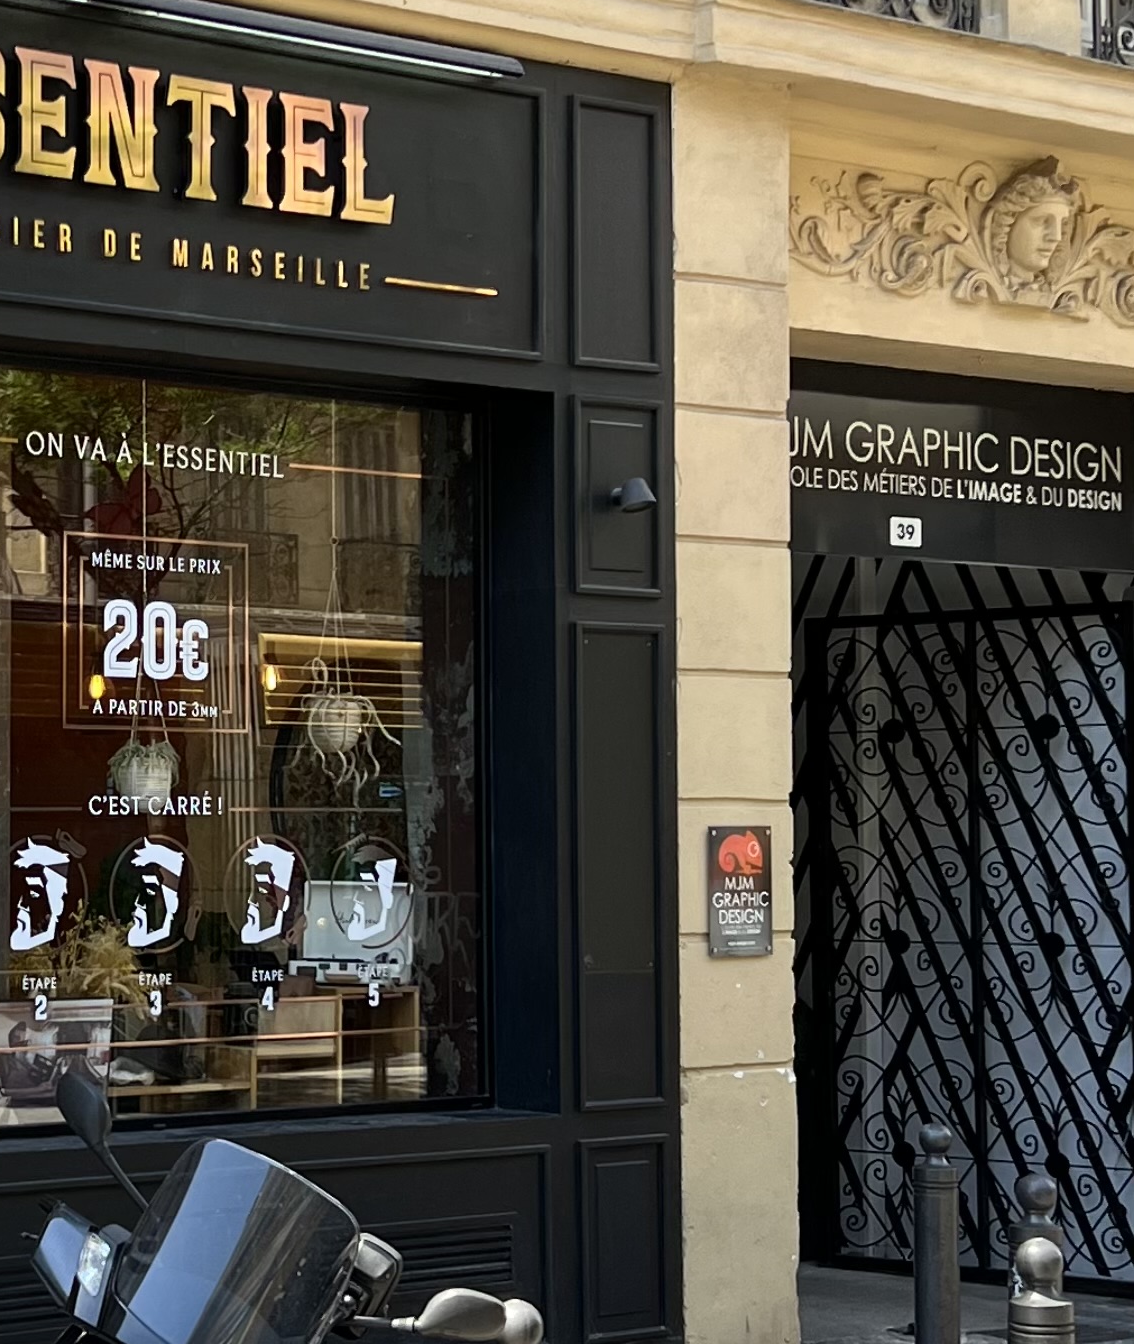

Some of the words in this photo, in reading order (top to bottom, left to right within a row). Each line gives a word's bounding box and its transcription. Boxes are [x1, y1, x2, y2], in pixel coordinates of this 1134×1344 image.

[104, 228, 141, 261] DE
[173, 238, 370, 290] MARSEILLE
[26, 430, 63, 457] ON
[74, 434, 107, 462] VA
[116, 433, 133, 464] À
[143, 442, 285, 479] L'ESSENTIEL
[789, 416, 834, 459] JM
[846, 421, 999, 473] GRAPHIC
[1010, 436, 1122, 483] DESIGN
[828, 469, 858, 491] DES
[864, 468, 926, 498] MÉTIERS
[931, 477, 953, 498] DE
[957, 480, 1022, 504] L'IMAGE
[1026, 486, 1037, 505] &
[1042, 487, 1063, 506] DU
[1067, 489, 1123, 511] DESIGN
[896, 523, 915, 541] 39
[92, 549, 132, 569] MÊME
[137, 555, 165, 572] SUR
[169, 557, 185, 573] LE
[189, 558, 221, 575] PRIX
[103, 599, 209, 681] 20€
[109, 699, 164, 716] PARTIR
[168, 701, 187, 717] DE
[88, 795, 141, 816] C'EST
[148, 790, 212, 816] CARRÉ
[725, 876, 754, 890] MJM
[712, 891, 769, 908] GRAPHIC
[719, 908, 764, 924] DESIGN
[22, 975, 57, 991] ÉTAPE
[138, 973, 172, 986] ÉTAPE
[251, 967, 284, 982] ÉTAPE
[34, 995, 48, 1020] 2
[150, 990, 162, 1017] 3
[262, 986, 275, 1011] 4
[368, 983, 380, 1007] 5
